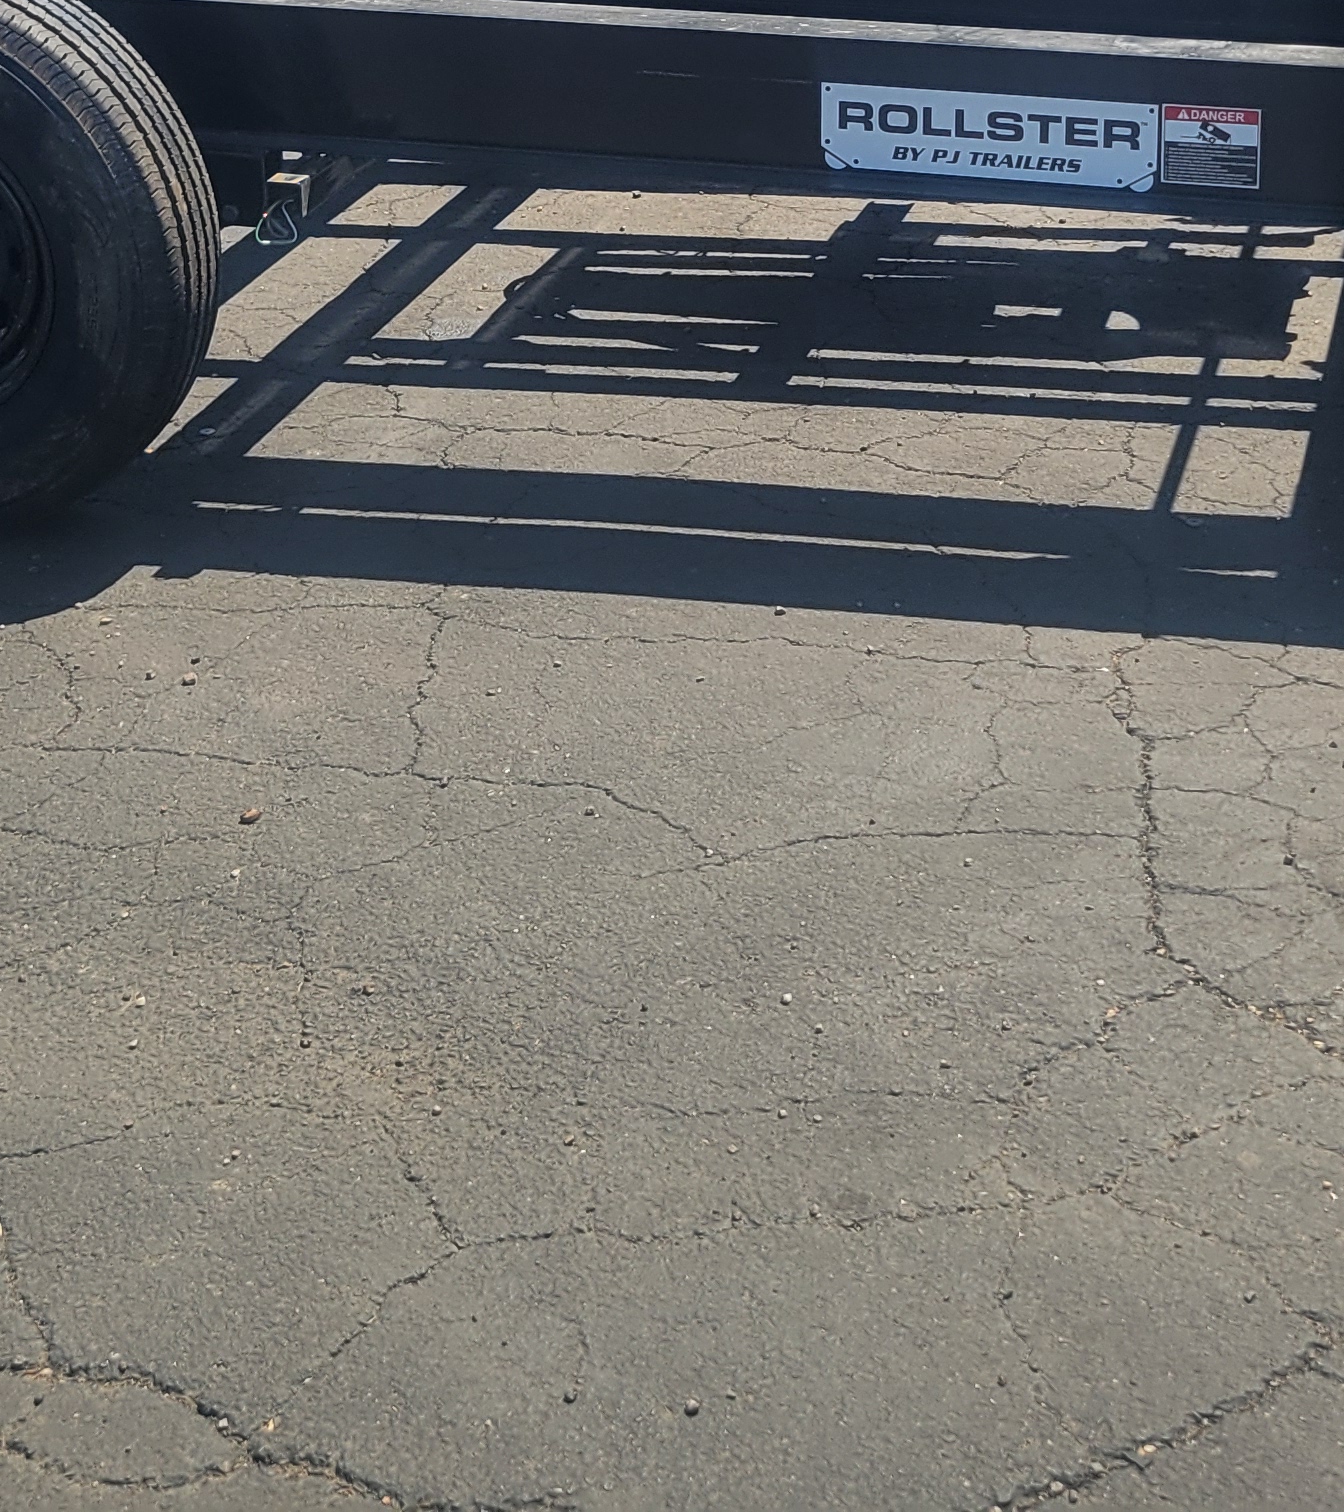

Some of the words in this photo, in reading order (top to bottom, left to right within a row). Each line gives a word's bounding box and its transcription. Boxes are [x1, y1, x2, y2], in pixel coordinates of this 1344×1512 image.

[838, 100, 1141, 150] ROLLSTER
[1191, 110, 1245, 122] DANGER
[891, 146, 925, 161] BY
[931, 149, 961, 164] PJ
[969, 152, 1083, 173] TRAILERS
